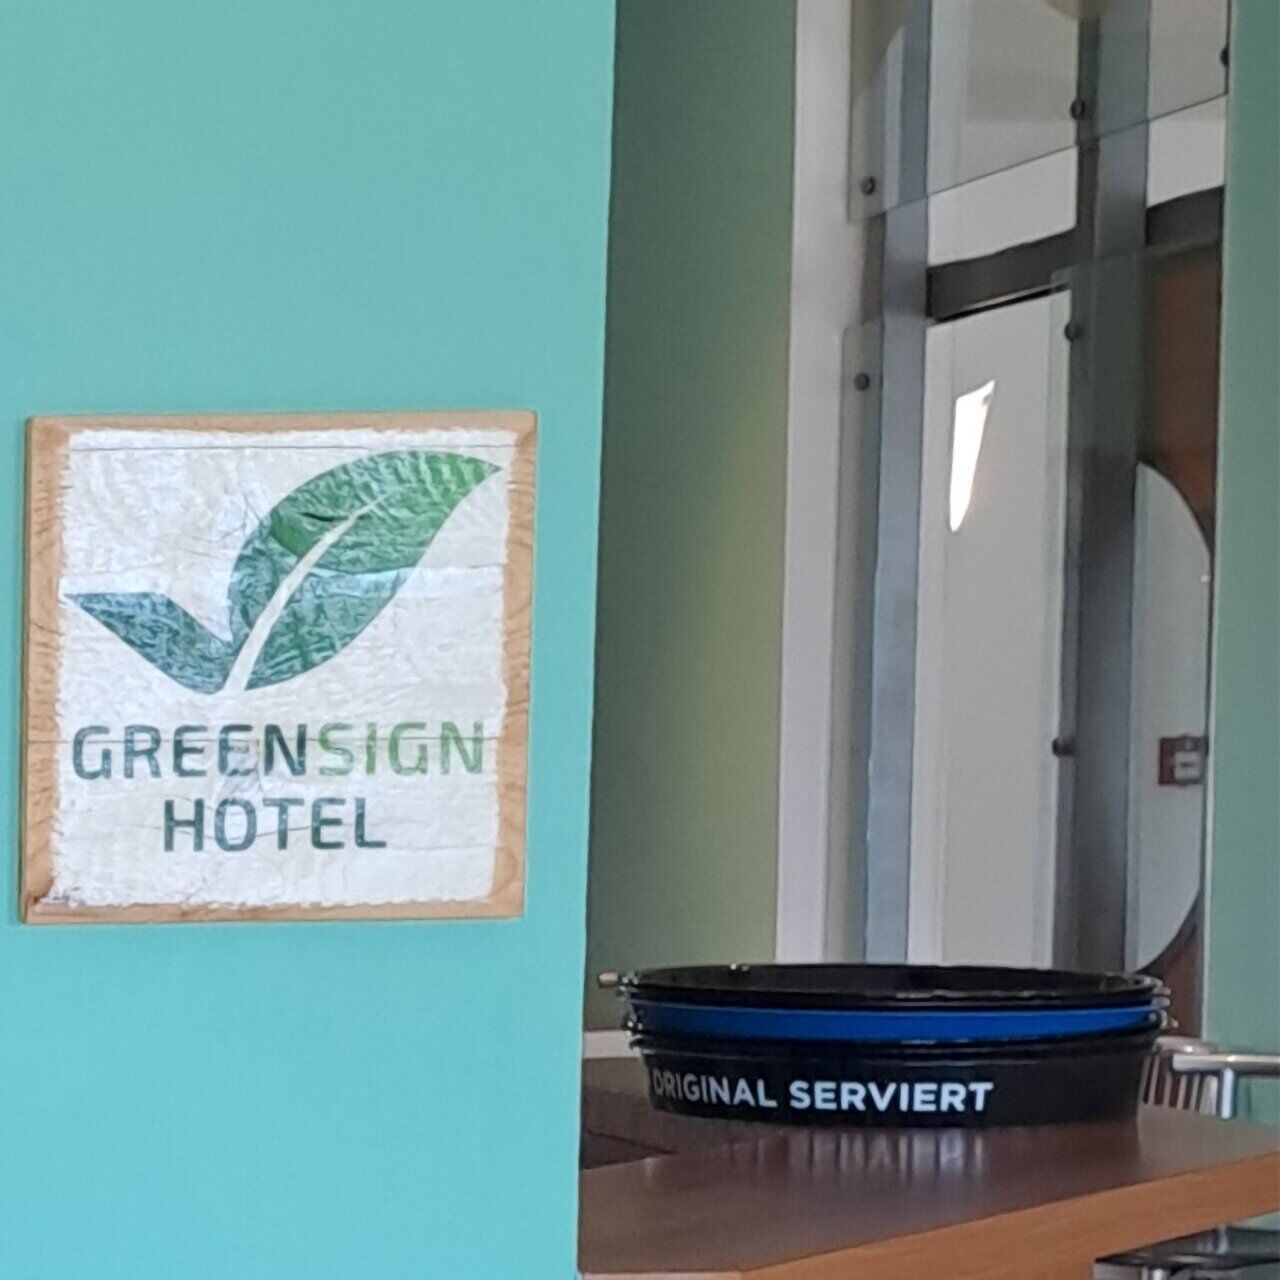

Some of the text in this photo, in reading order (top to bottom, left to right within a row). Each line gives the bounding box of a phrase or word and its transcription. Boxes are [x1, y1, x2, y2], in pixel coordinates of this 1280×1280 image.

[71, 721, 486, 780] GREENSIGN
[163, 796, 389, 853] HOTEL
[652, 1067, 995, 1113] ORIGINAL SERVIERT
